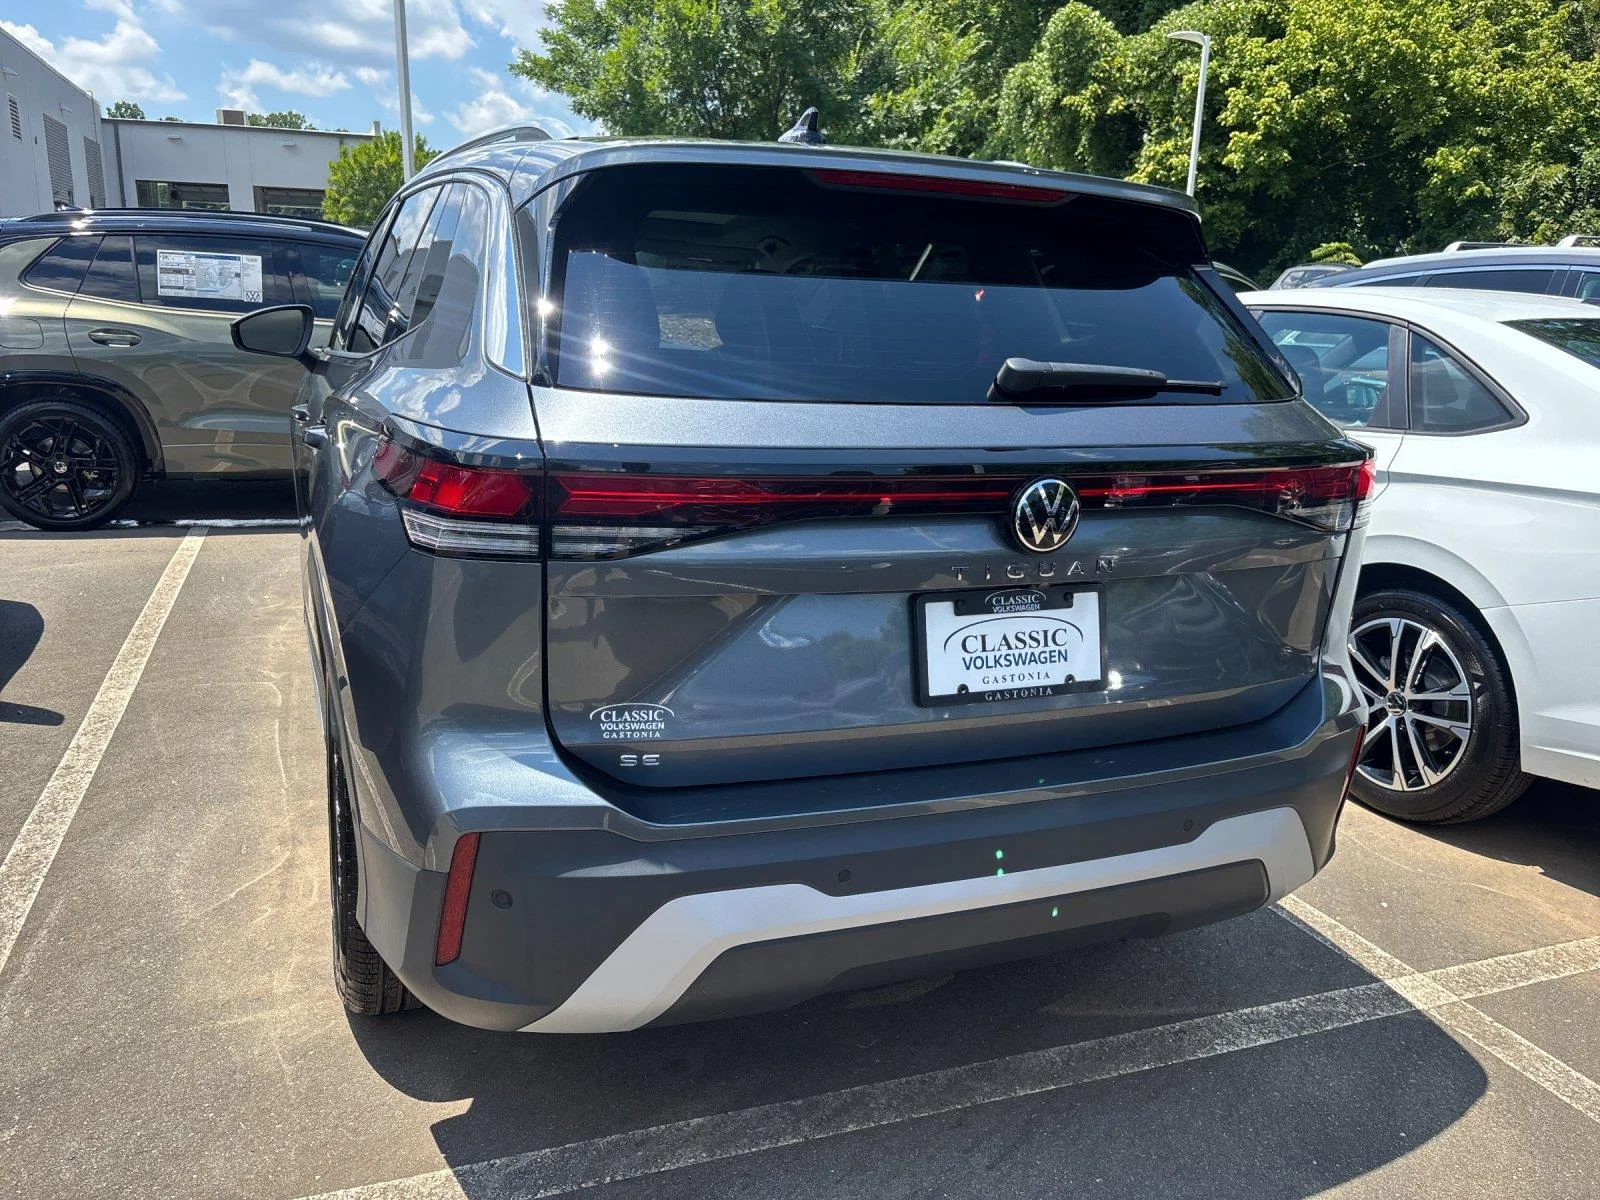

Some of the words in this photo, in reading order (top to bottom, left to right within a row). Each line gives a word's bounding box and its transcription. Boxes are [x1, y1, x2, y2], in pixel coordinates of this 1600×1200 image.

[951, 558, 1116, 581] TIGUAN
[992, 594, 1040, 606] CLASSIC
[992, 603, 1041, 613] VOLKSWAGEN
[961, 628, 1067, 654] CLASSIC
[962, 649, 1068, 671] VOLKSWAGEN
[982, 671, 1051, 685] GASTONIA
[985, 686, 1053, 701] GASTONIA
[600, 709, 664, 722] CLASSIC
[600, 722, 665, 731] VOLKSWAGEN
[603, 731, 661, 739] GASTONIA
[620, 754, 660, 767] SE
